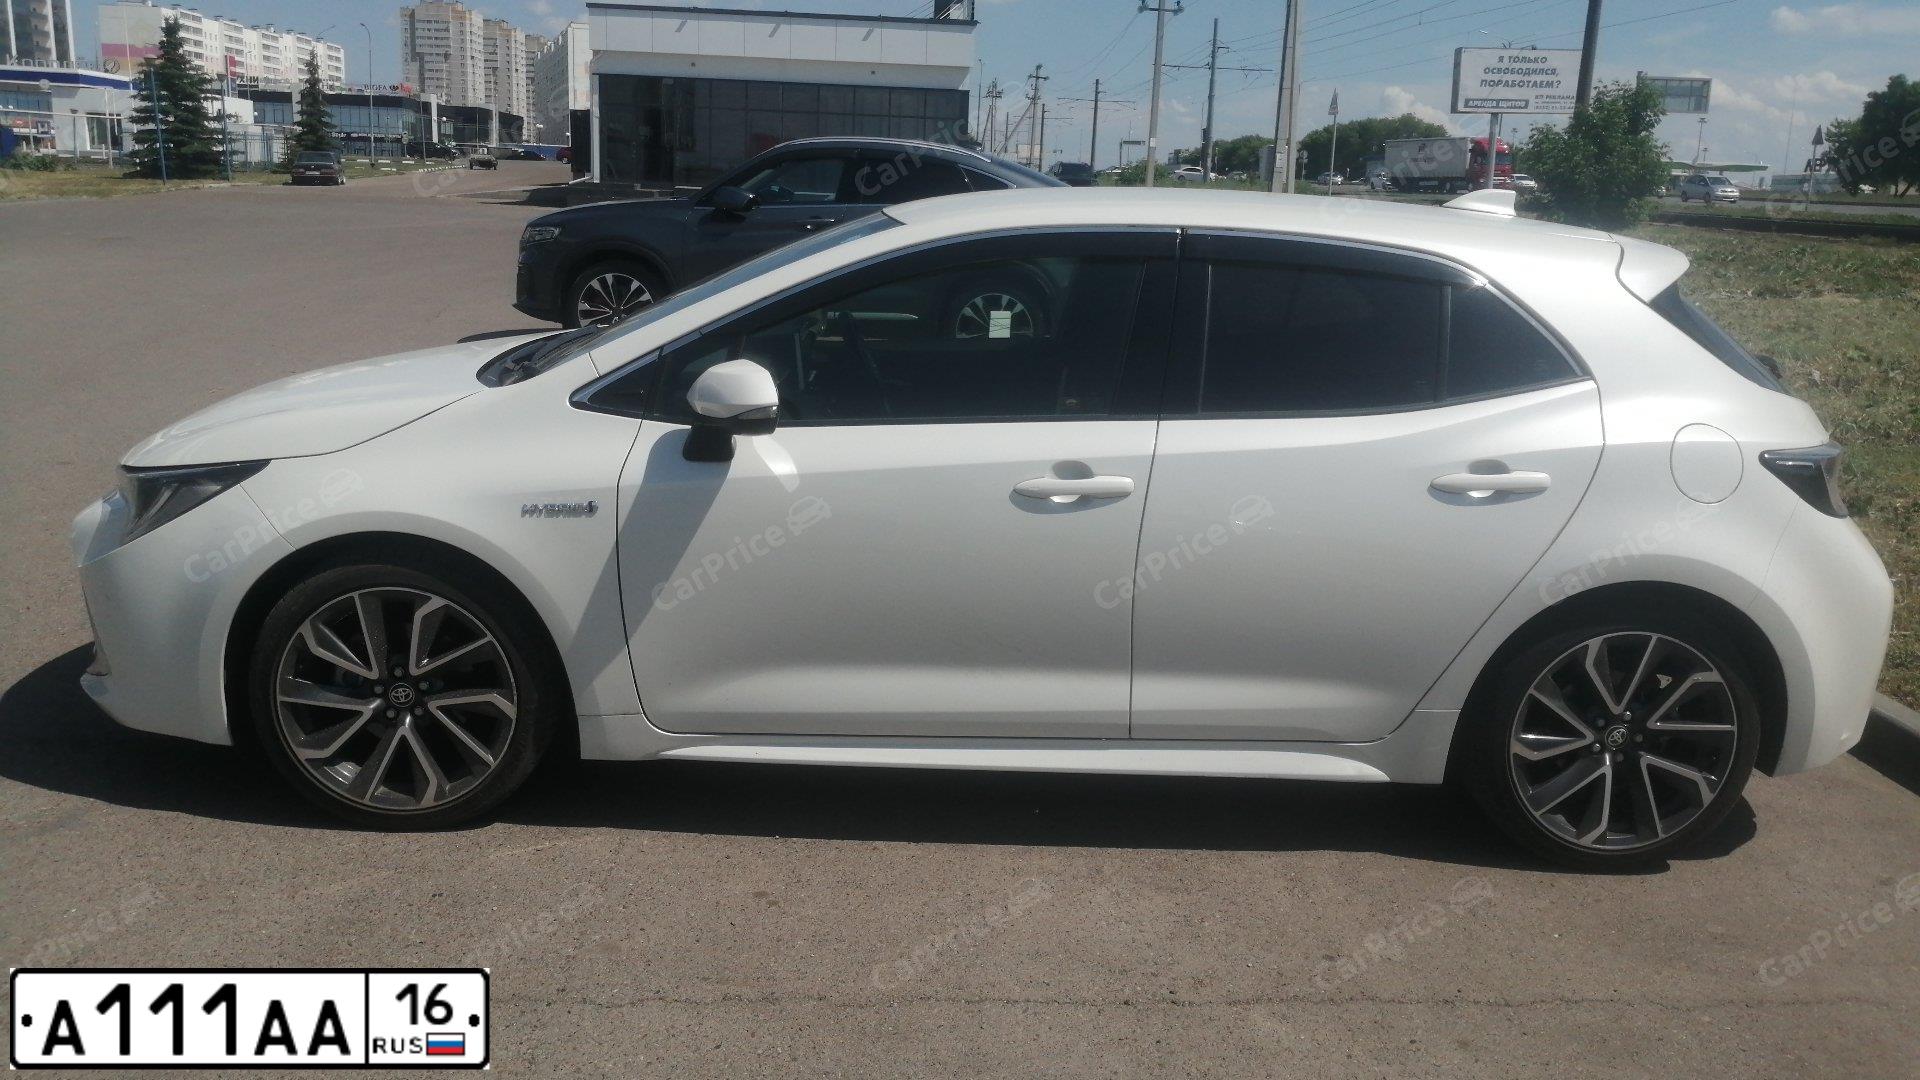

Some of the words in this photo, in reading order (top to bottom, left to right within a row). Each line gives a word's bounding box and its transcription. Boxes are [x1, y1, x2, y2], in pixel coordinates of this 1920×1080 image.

[1497, 55, 1505, 64] Я
[1508, 56, 1548, 64] ТОЛЬКО
[1483, 67, 1560, 77] ОСВОБОДИЛСЯ,
[1480, 79, 1562, 89] ПОРАБОТАЕМ?
[1467, 100, 1497, 108] АРЕНДА
